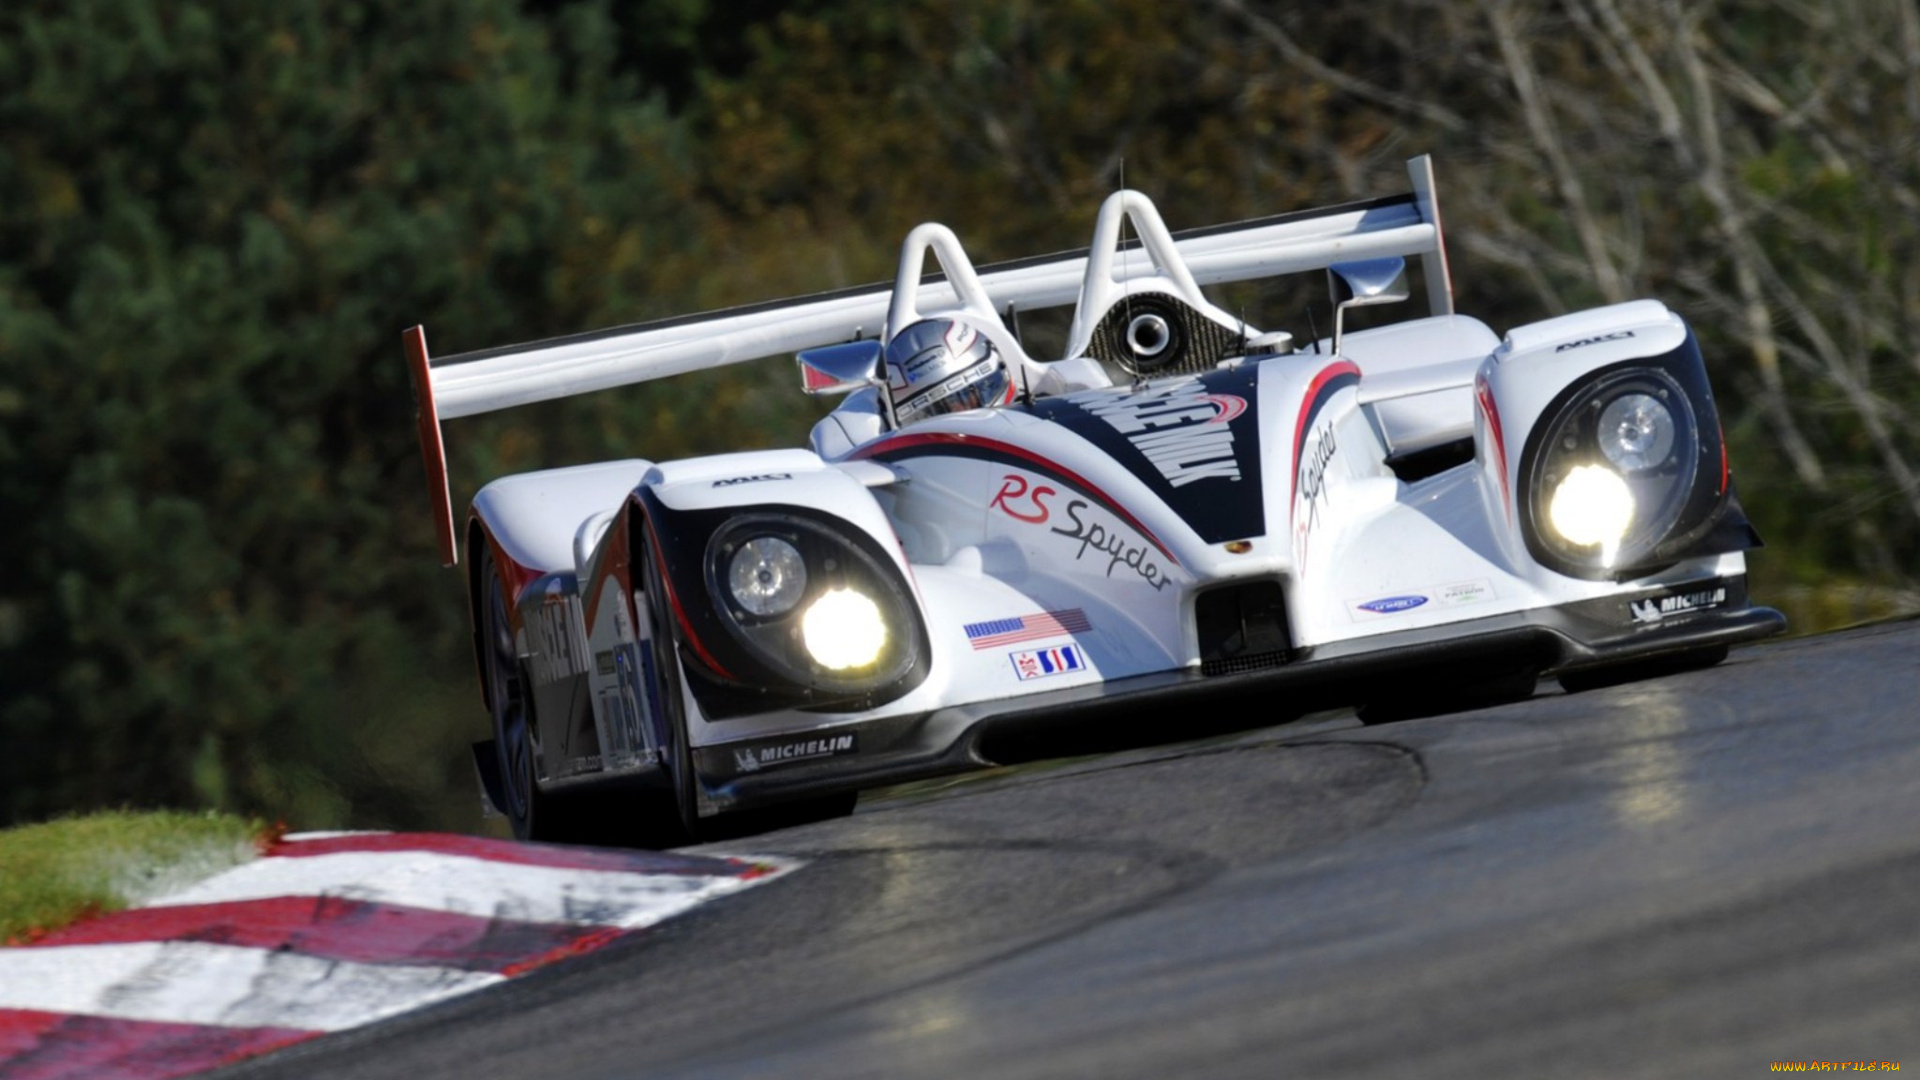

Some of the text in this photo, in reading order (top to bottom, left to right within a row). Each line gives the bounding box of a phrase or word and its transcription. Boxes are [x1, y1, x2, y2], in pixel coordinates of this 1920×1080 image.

[896, 362, 993, 420] ORSCHE
[1127, 420, 1241, 488] MILK
[1302, 419, 1336, 535] Spyder
[990, 474, 1172, 592] RS Spyder
[1661, 588, 1725, 613] MICHELIN
[760, 735, 854, 762] MICHELIN
